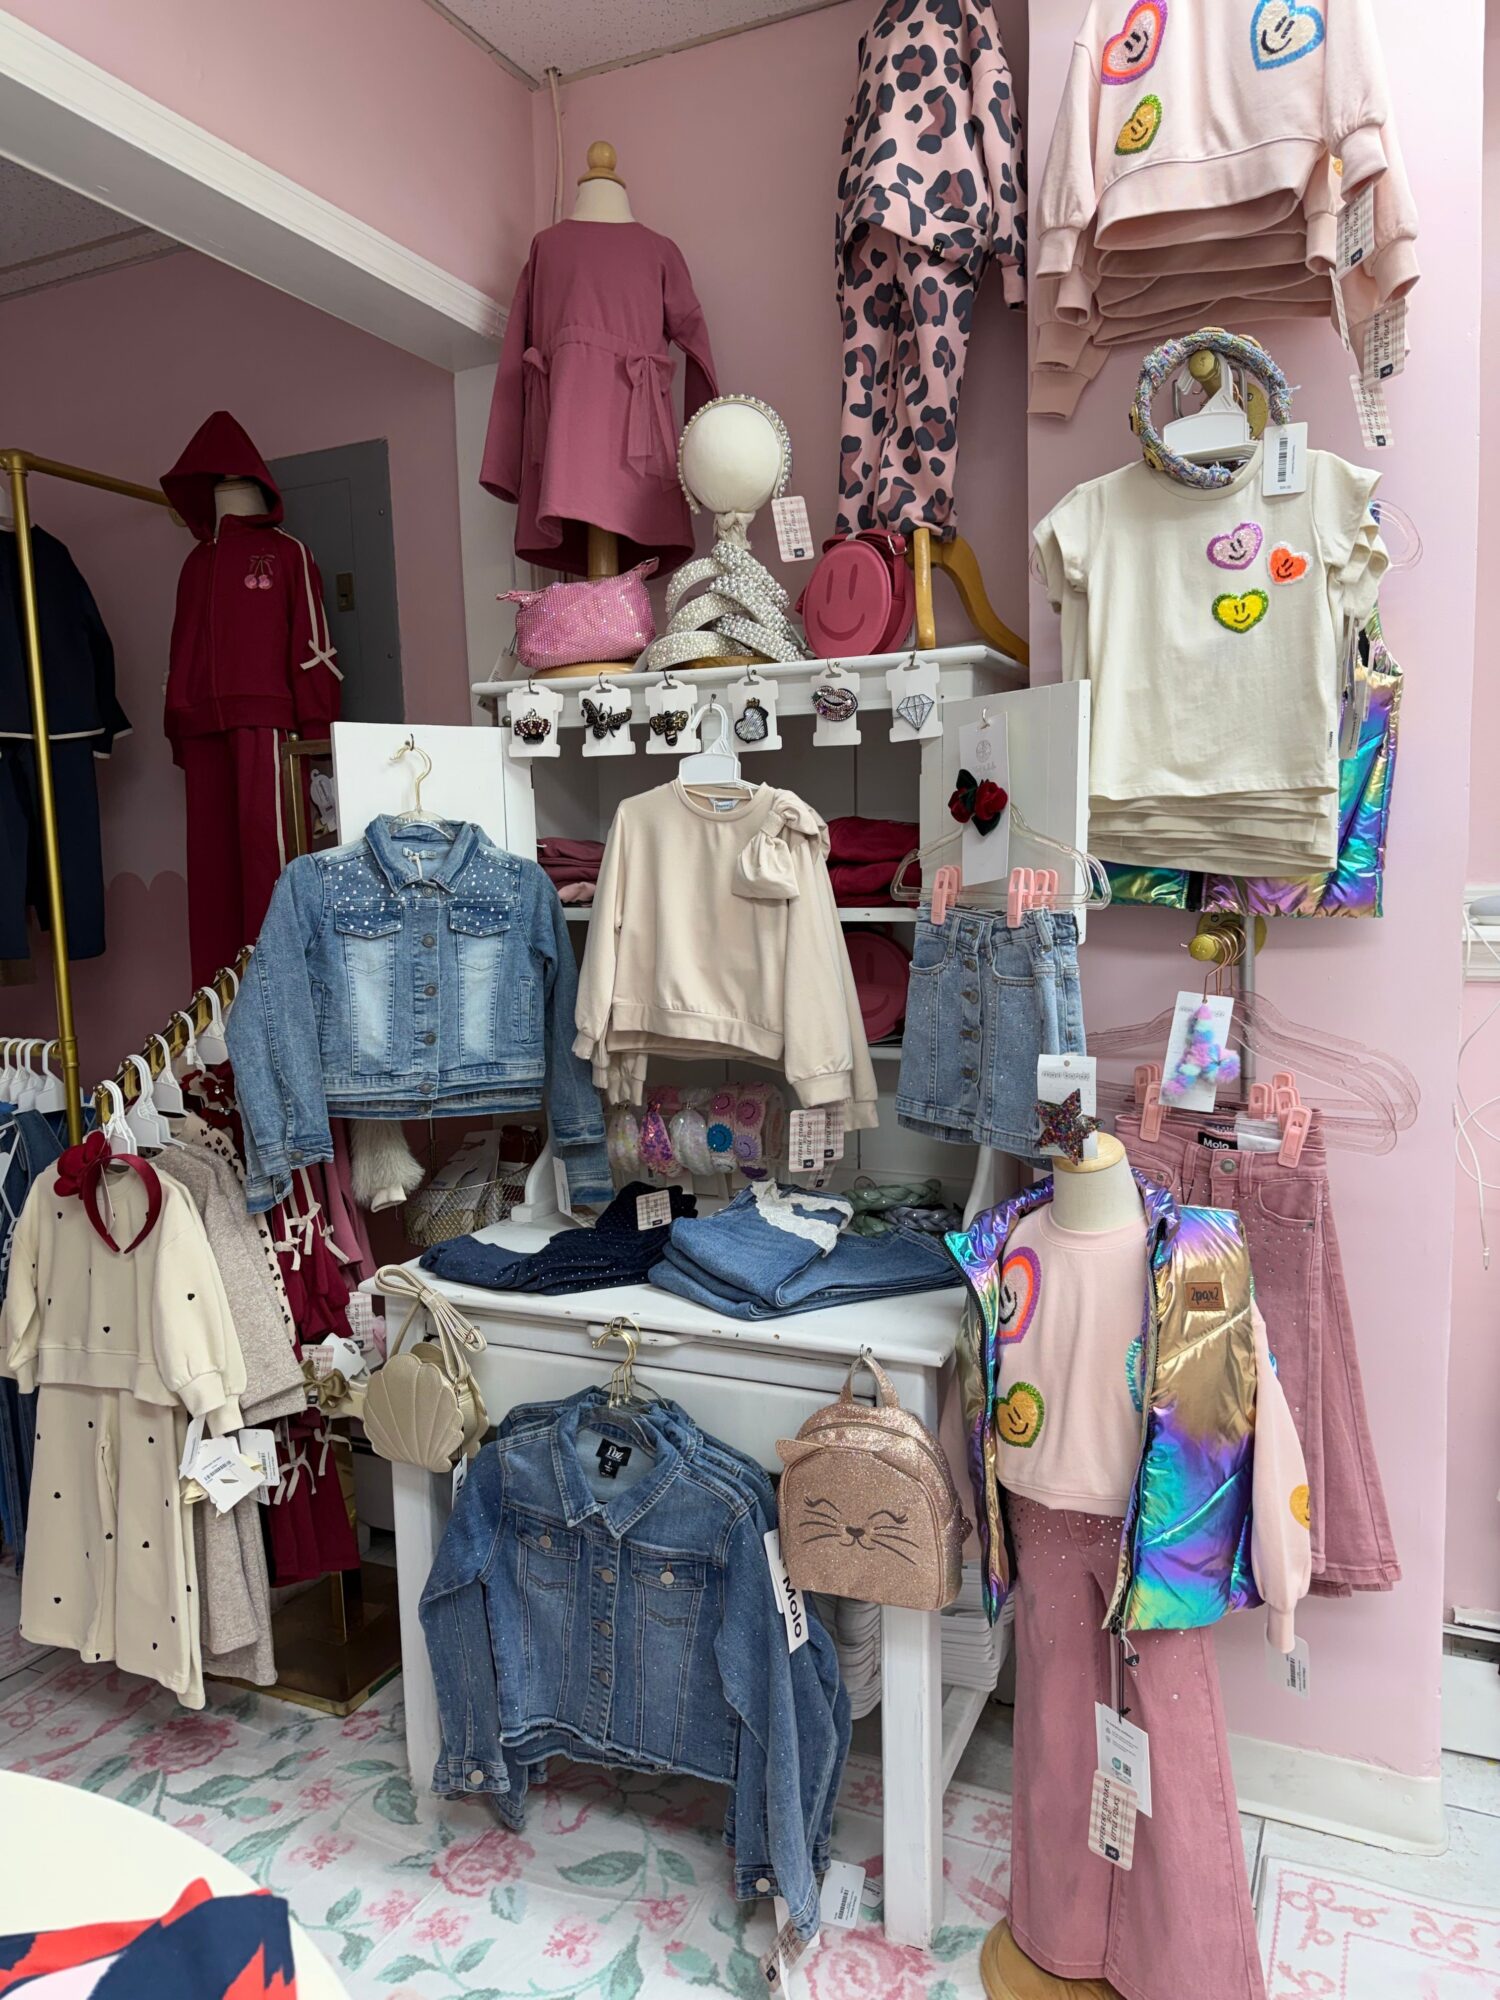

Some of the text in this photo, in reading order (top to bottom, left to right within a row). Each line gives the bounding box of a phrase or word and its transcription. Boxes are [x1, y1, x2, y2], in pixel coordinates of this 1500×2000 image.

[1203, 1138, 1229, 1149] Molo
[783, 1576, 801, 1638] Molo
[1099, 1778, 1111, 1850] DIFFERENT STROKES
